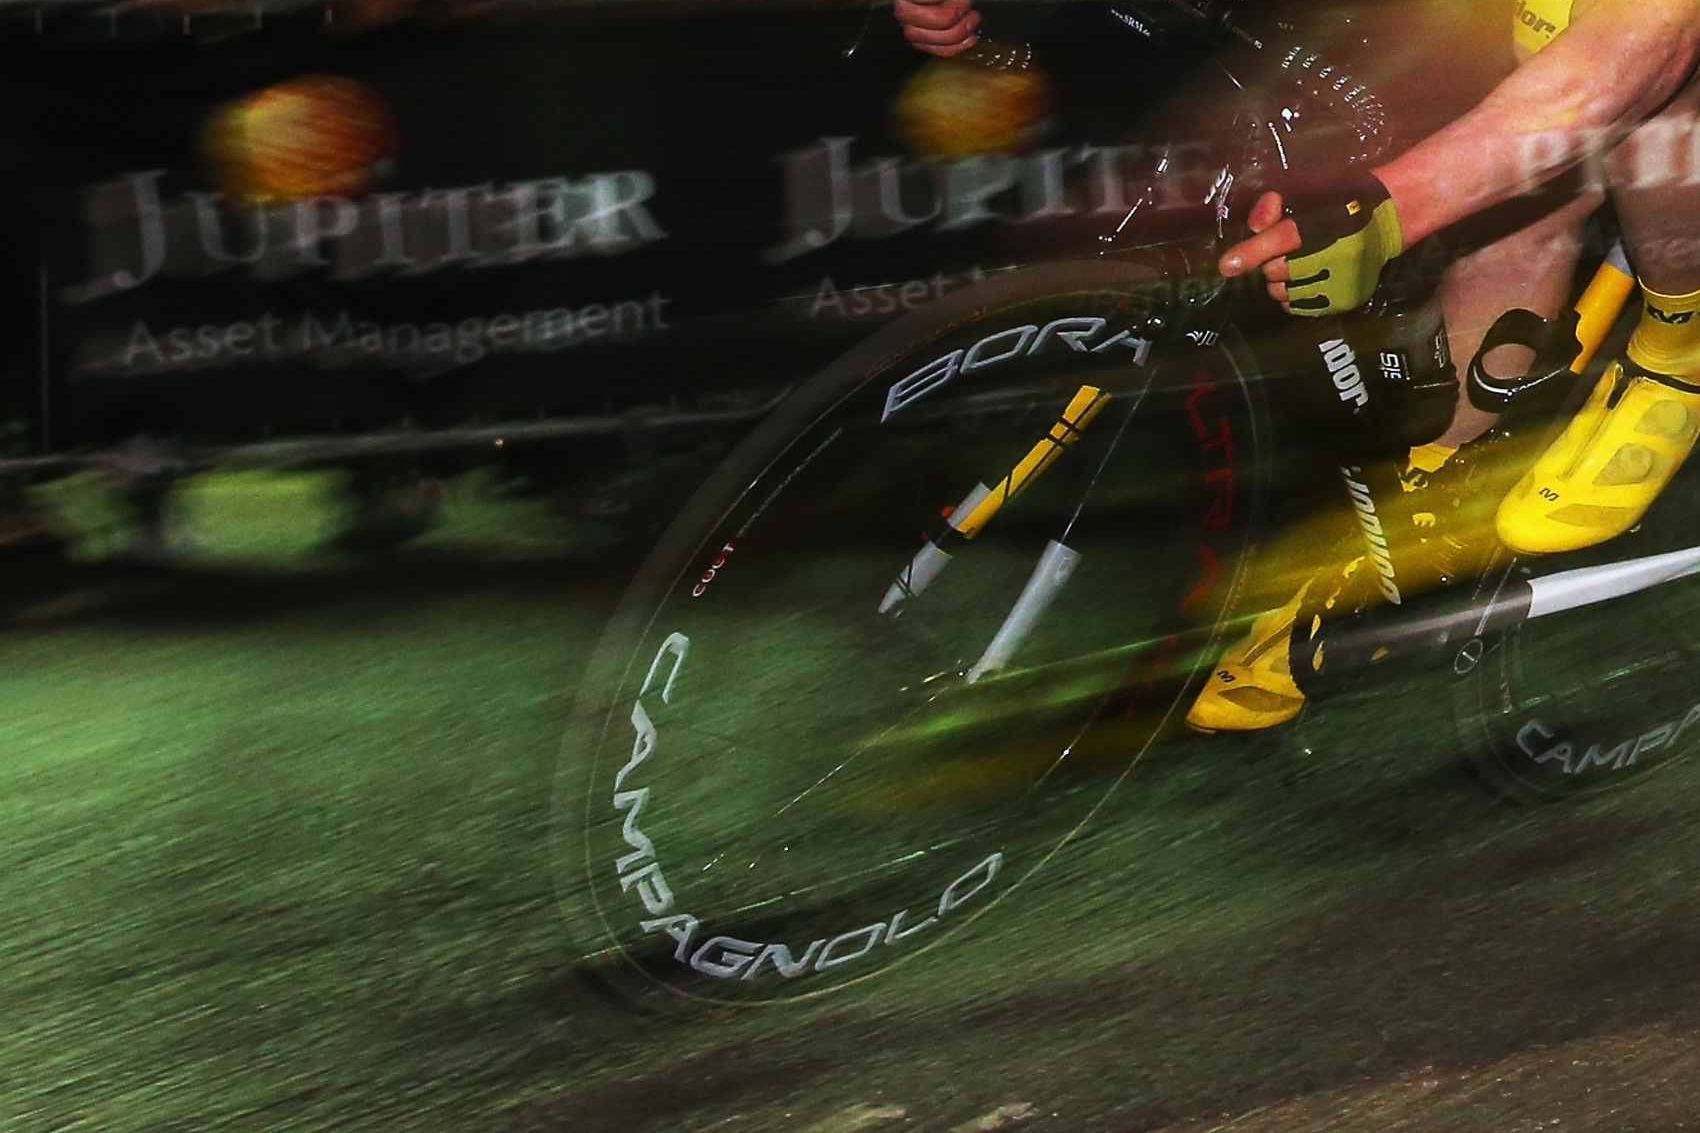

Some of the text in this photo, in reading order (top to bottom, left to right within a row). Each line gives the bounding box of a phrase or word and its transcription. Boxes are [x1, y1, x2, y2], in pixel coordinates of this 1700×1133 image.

[80, 168, 670, 298] JUPITER
[118, 289, 672, 365] Asset Management
[808, 272, 952, 319] Asset
[880, 317, 1152, 424] BORA
[612, 632, 1002, 981] CAMPAGNOLO
